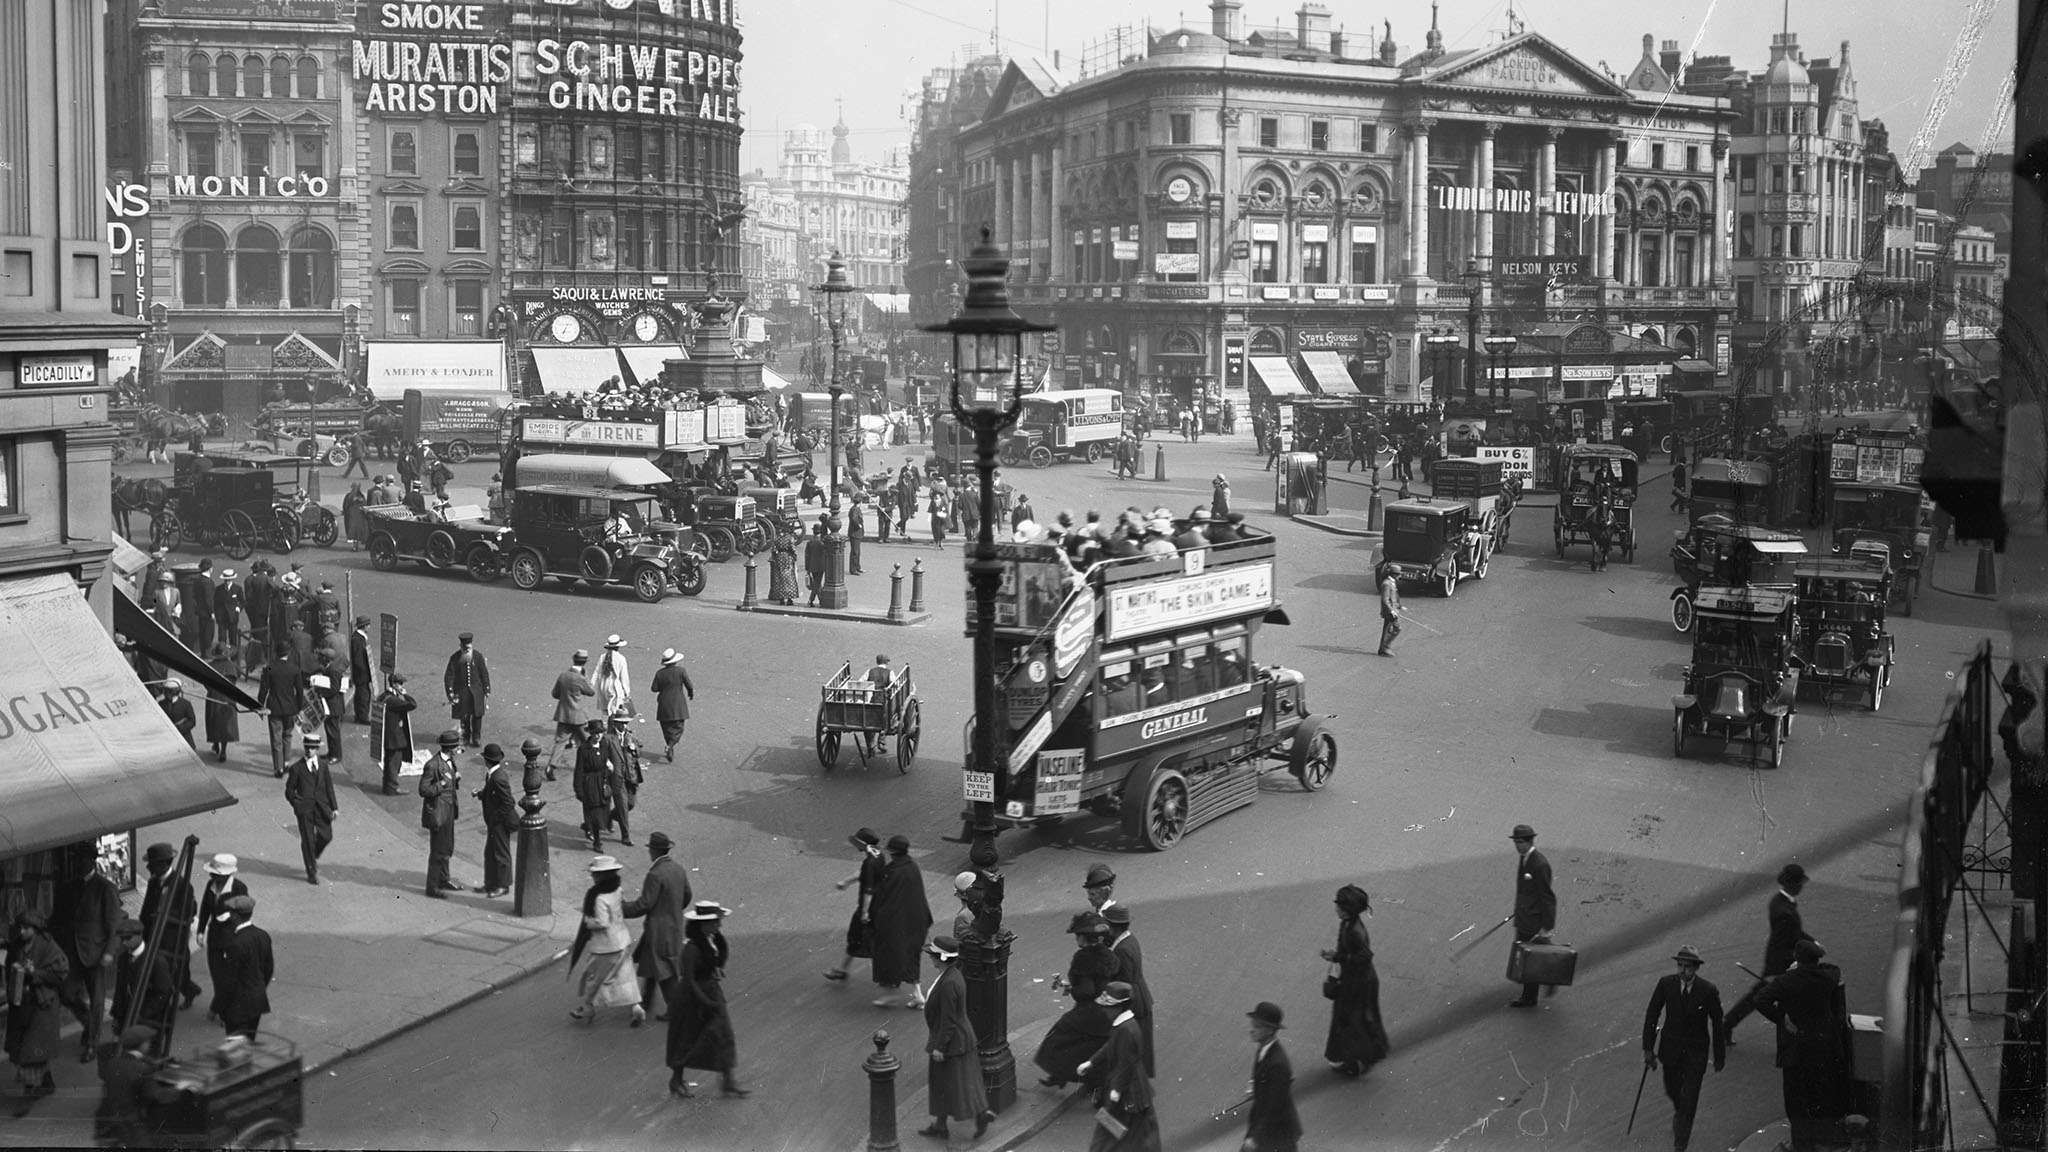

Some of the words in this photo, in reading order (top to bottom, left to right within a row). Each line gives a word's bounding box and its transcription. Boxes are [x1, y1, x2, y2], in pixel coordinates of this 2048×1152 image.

[381, 4, 483, 30] SMOKE
[536, 39, 744, 94] SCHWEPPES
[1503, 60, 1546, 72] LONDON
[1491, 69, 1557, 84] PAVILION
[365, 83, 496, 114] ARISTON
[549, 81, 677, 116] GINGER
[699, 92, 737, 123] ALE
[1630, 116, 1687, 130] PAVILION
[174, 175, 328, 197] MONICO
[1497, 189, 1531, 213] PARIS
[1556, 190, 1578, 215] NEW
[1582, 193, 1608, 216] YORK
[1502, 262, 1542, 275] NELSON
[1549, 262, 1578, 274] KEYS
[552, 287, 589, 302] SAQUI
[590, 288, 600, 302] &
[602, 288, 665, 301] LAWRENCE
[1298, 330, 1324, 346] STATE
[24, 365, 85, 382] PICCADILLY
[383, 368, 428, 376] AMERY
[431, 368, 439, 376] &
[444, 368, 494, 377] LOADER
[1563, 369, 1589, 378] NELSON
[1591, 369, 1611, 377] KEYS
[585, 410, 593, 418] 3
[1512, 448, 1529, 459] 6%
[1509, 470, 1533, 479] BONDS
[1191, 553, 1199, 571] 9
[1160, 595, 1182, 614] THE
[1187, 590, 1214, 608] SKIN
[1141, 707, 1208, 739] GENERAL
[1039, 755, 1083, 777] VASELINE
[966, 774, 992, 784] KEEP
[966, 789, 992, 799] LEFT
